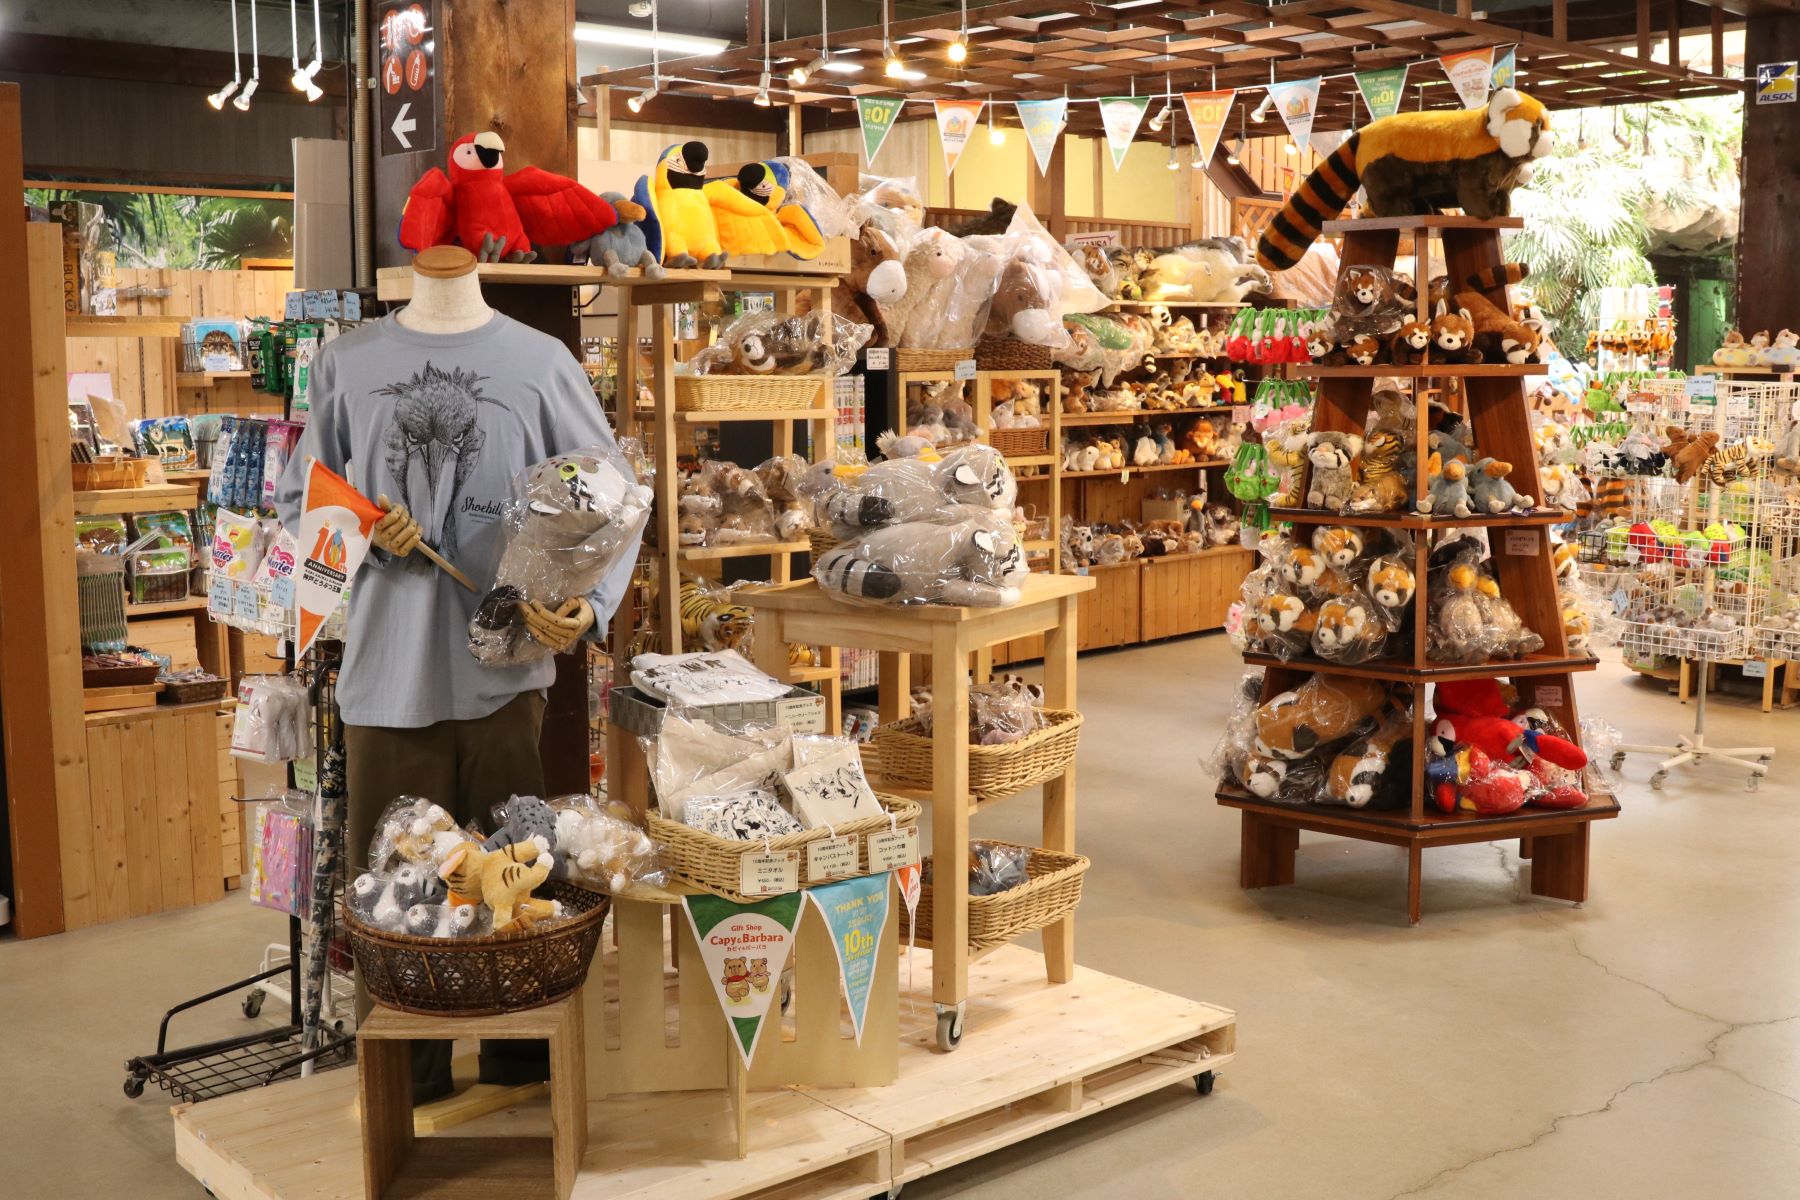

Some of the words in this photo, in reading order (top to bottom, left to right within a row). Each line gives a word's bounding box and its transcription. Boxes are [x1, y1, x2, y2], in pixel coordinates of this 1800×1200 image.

[1760, 92, 1793, 101] ALSOK
[63, 264, 74, 298] BUCK
[461, 496, 504, 516] Shoebill
[303, 573, 341, 593] 神戸どうぶつ王国
[834, 898, 864, 912] THANK
[844, 929, 873, 956] 10th
